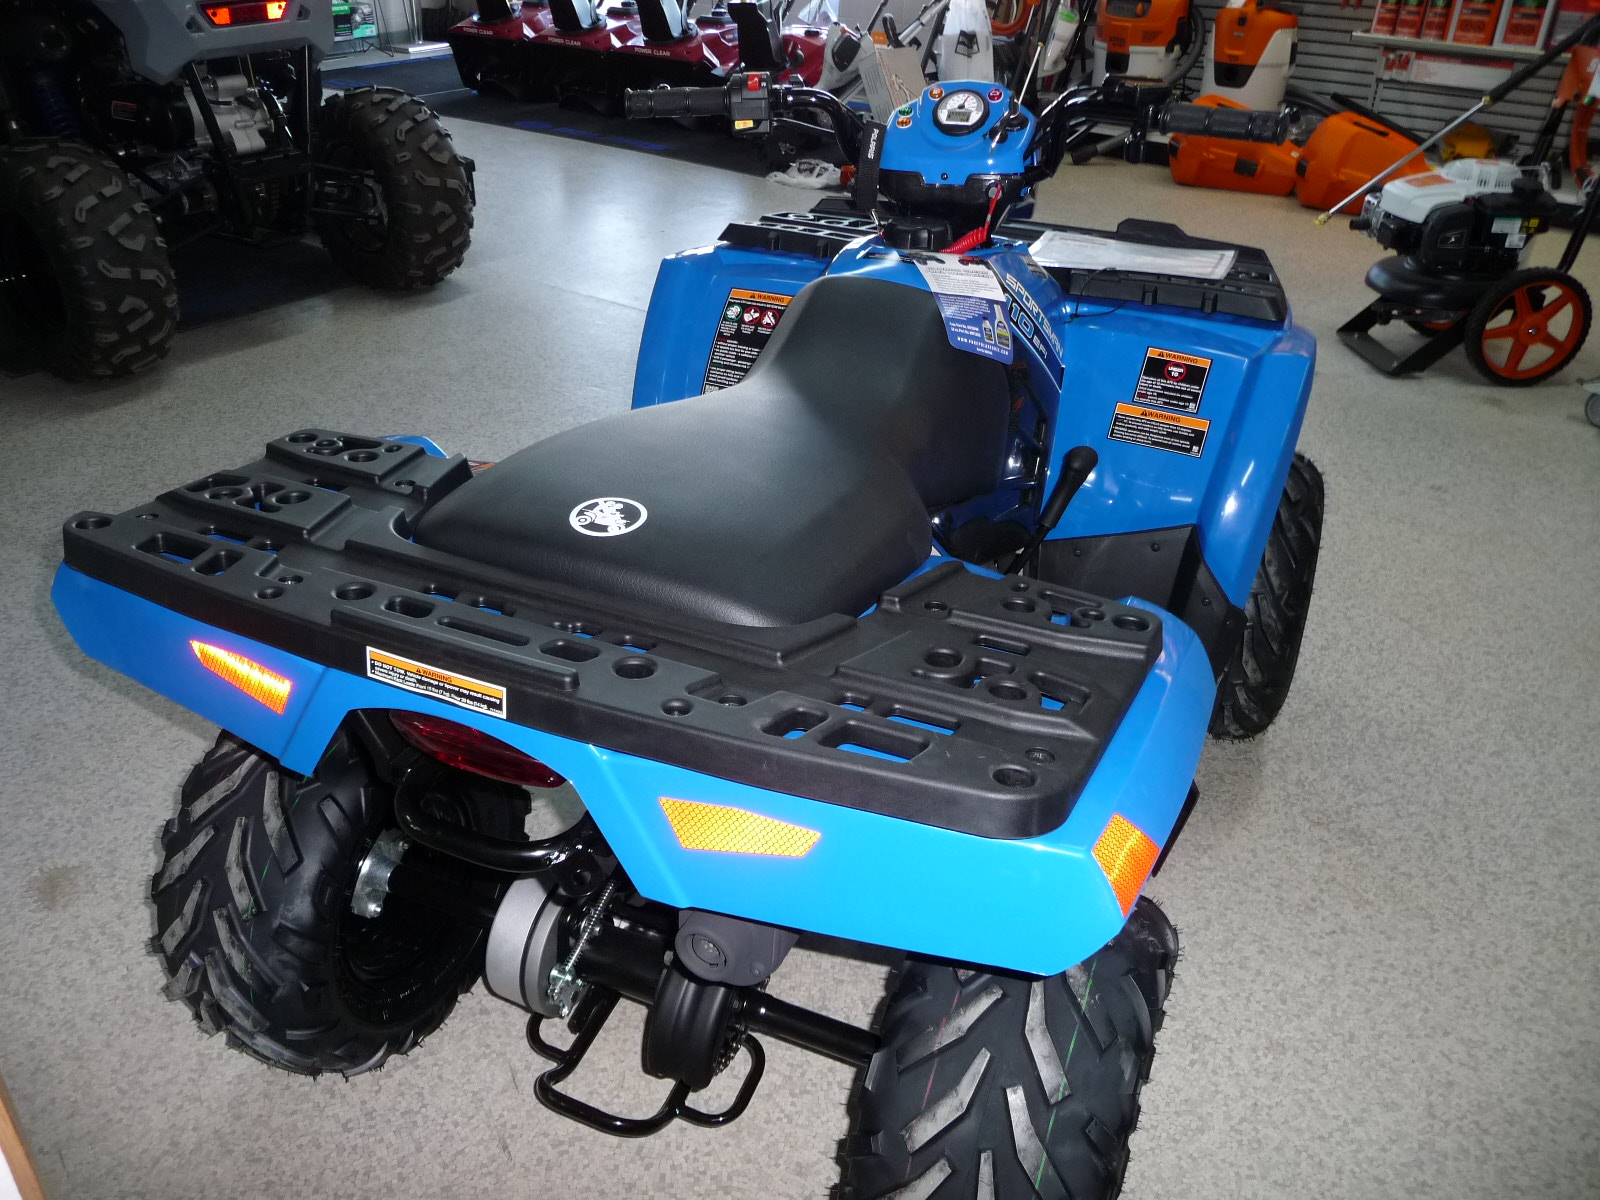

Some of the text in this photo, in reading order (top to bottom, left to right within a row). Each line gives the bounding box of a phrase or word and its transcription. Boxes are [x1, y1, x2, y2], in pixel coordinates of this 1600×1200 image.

[868, 128, 879, 159] POLARIS
[758, 294, 784, 303] WARNING
[1004, 294, 1034, 338] 110
[1006, 272, 1064, 358] SPORTSMAN
[1032, 334, 1048, 359] EFI
[1166, 352, 1198, 364] WARNING
[1147, 411, 1181, 423] WARNING
[422, 668, 452, 683] WARNING
